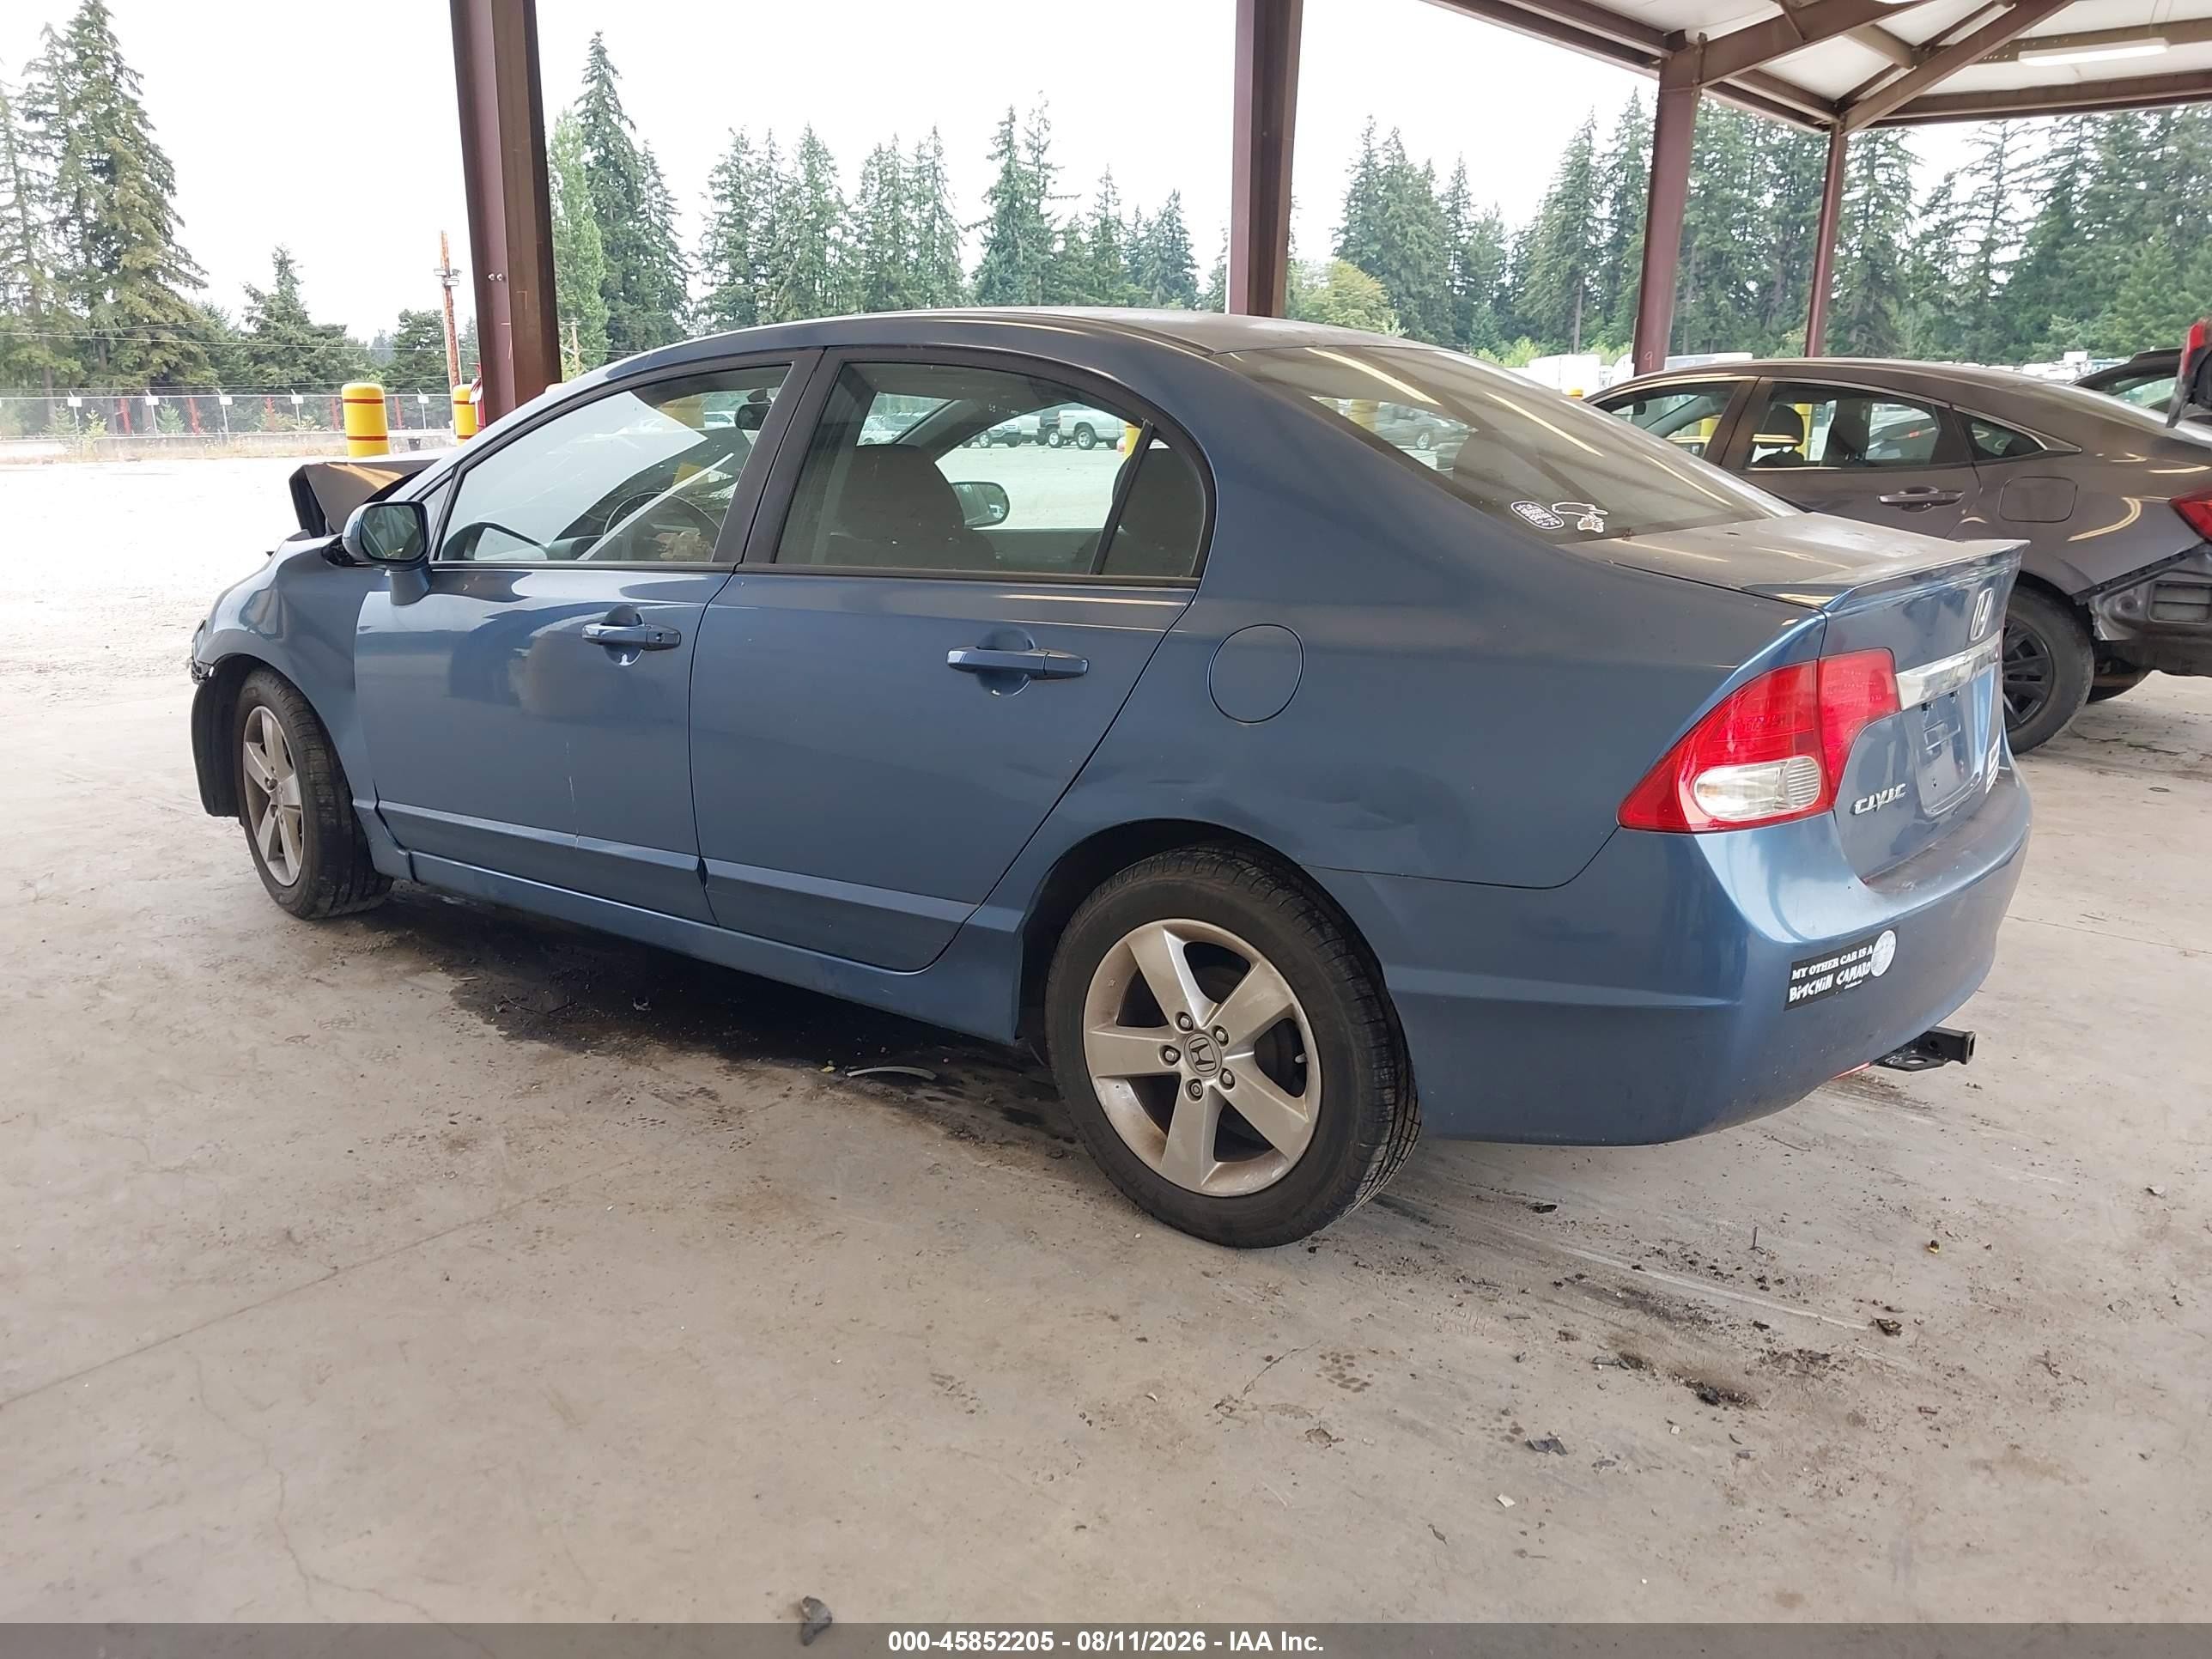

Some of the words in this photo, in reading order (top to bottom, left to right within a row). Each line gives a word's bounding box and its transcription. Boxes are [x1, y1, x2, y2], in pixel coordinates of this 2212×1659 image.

[1644, 350, 1654, 370] 9
[1851, 783, 1908, 816] CIVIC
[1791, 967, 1809, 981] MY
[1808, 957, 1839, 975] OTHER
[1839, 951, 1857, 965] CAR
[1857, 946, 1868, 959] IS
[1866, 944, 1874, 957] A
[1836, 961, 1872, 986] CAMARO
